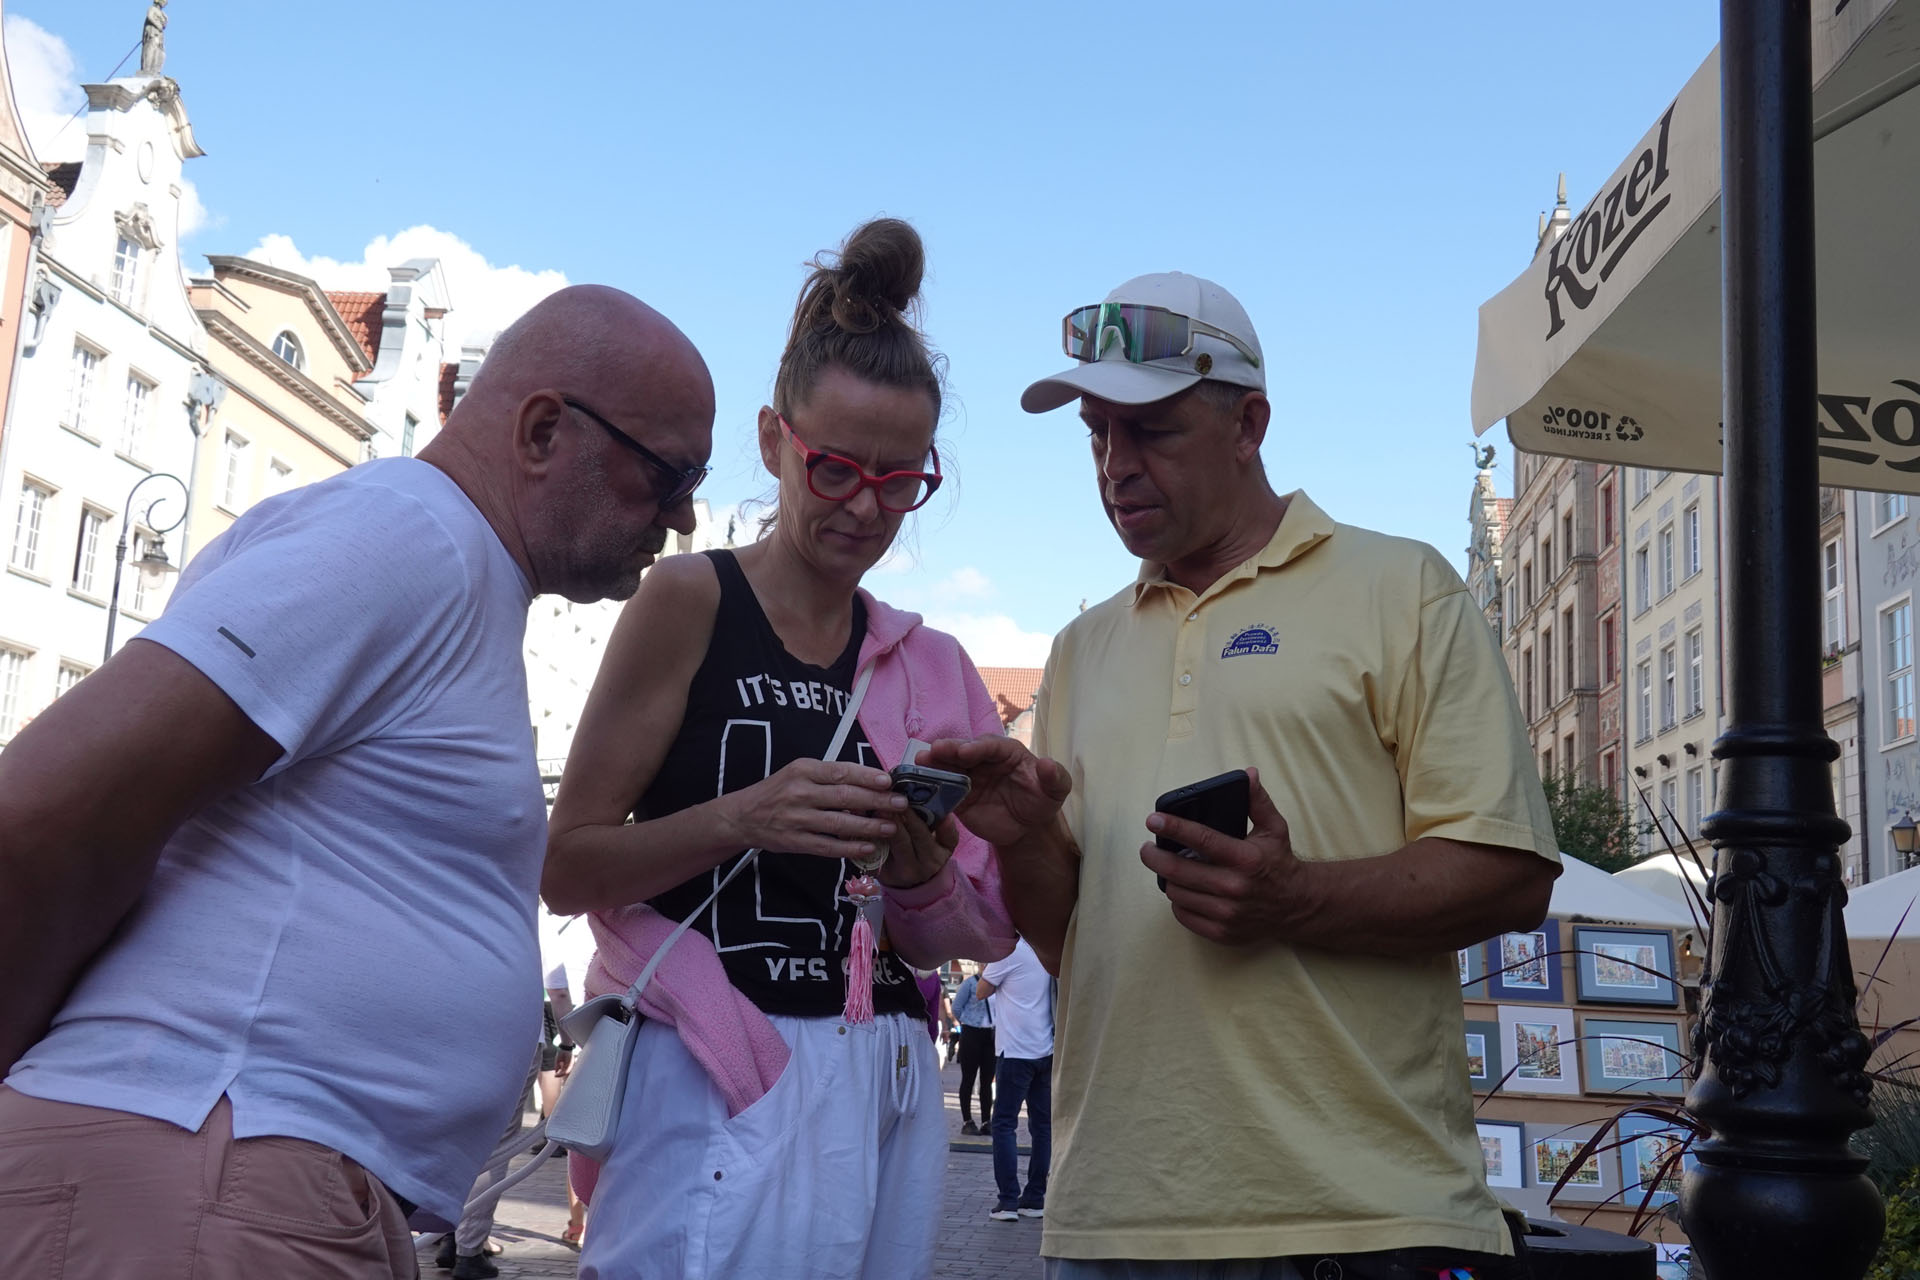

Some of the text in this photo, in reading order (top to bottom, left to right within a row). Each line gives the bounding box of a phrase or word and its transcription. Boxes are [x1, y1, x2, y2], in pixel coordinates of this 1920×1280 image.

[1545, 97, 1679, 342] Kozel
[1223, 644, 1276, 656] Falun Dafa
[736, 673, 788, 708] IT'S
